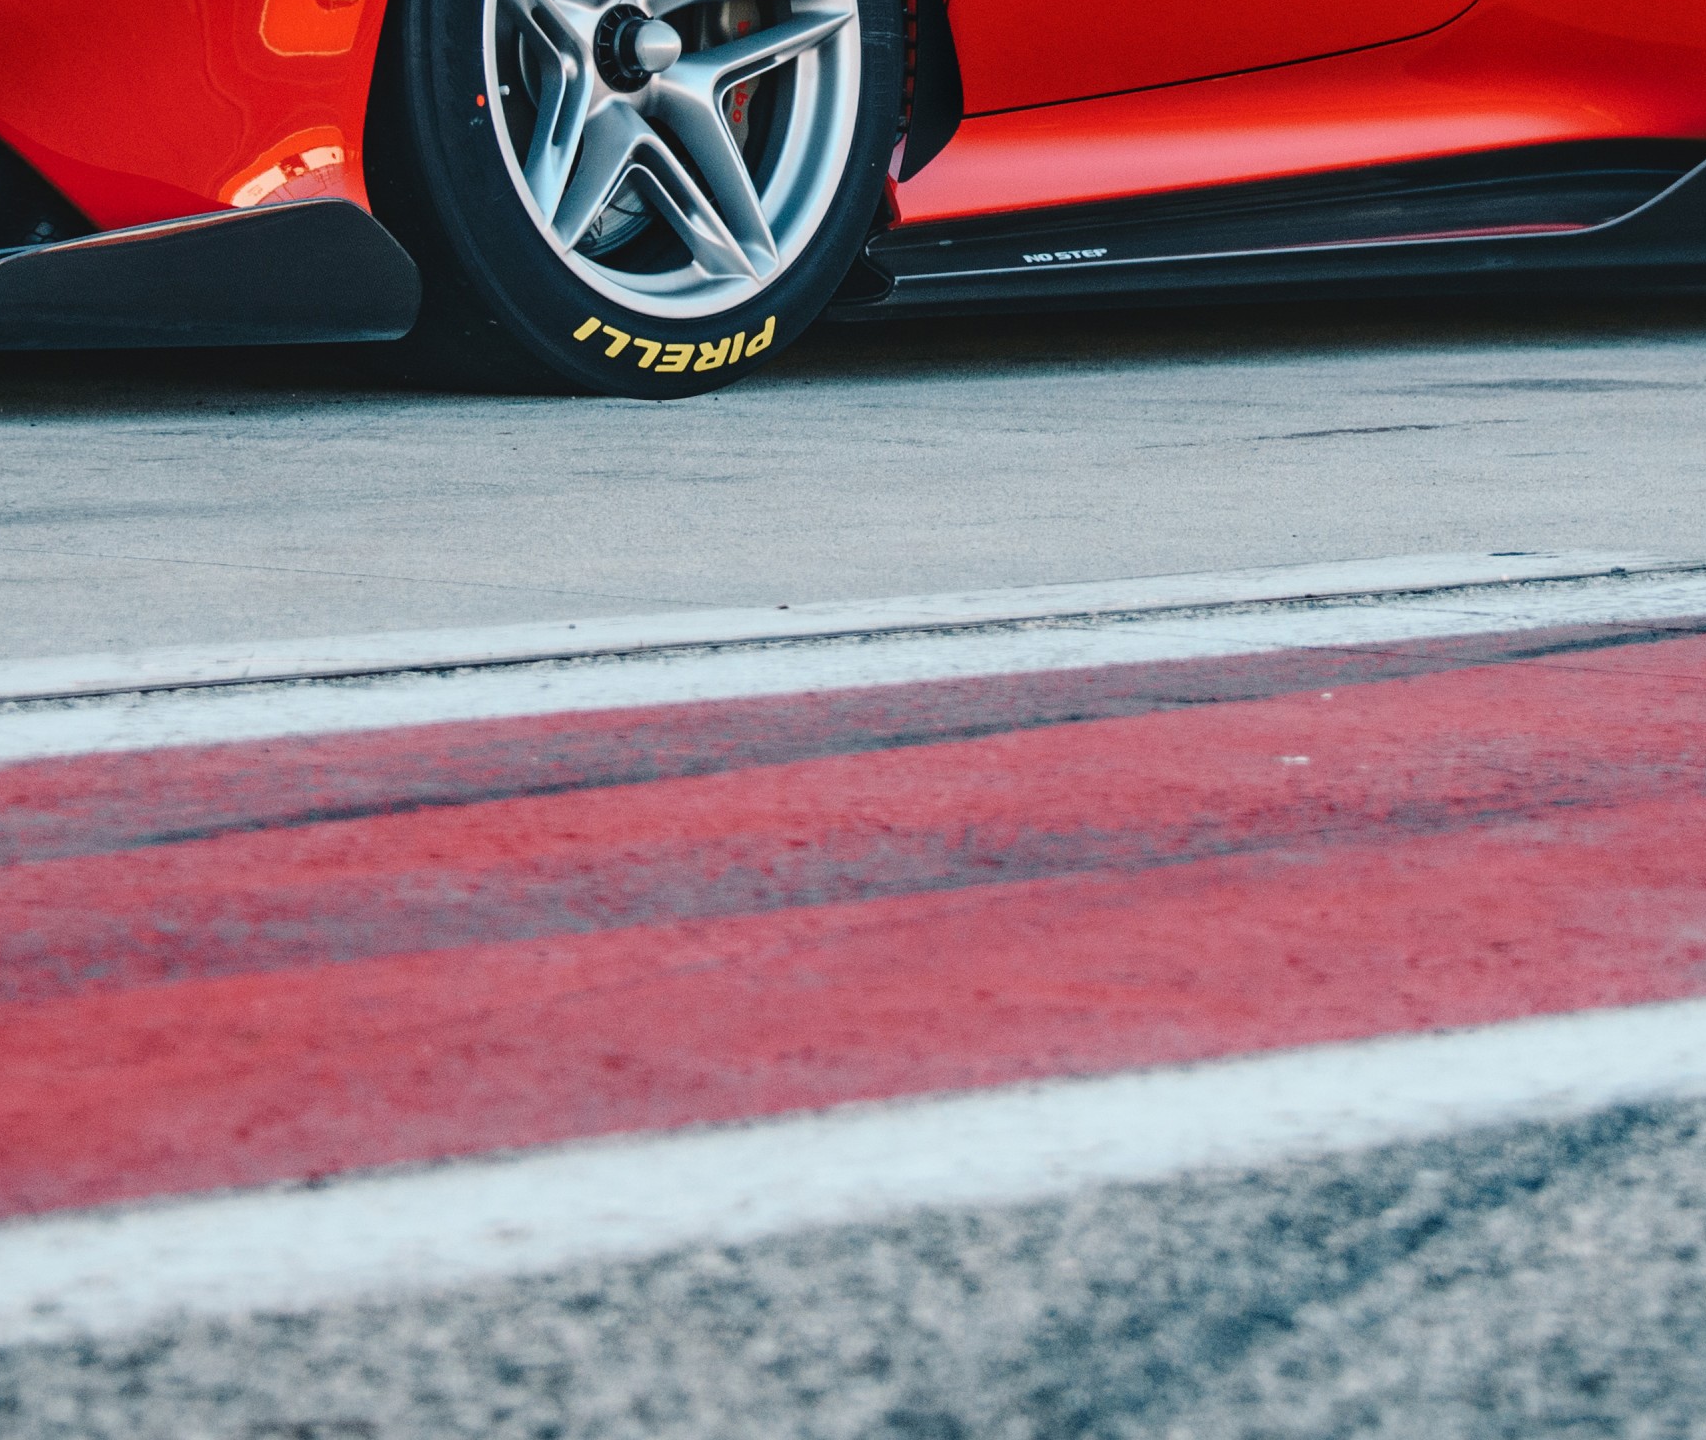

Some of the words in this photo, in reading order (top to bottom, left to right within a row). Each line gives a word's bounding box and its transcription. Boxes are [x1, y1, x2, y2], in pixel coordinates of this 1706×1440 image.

[1022, 253, 1054, 263] NO
[1054, 247, 1108, 261] STEP
[573, 315, 776, 372] PIRELLI
